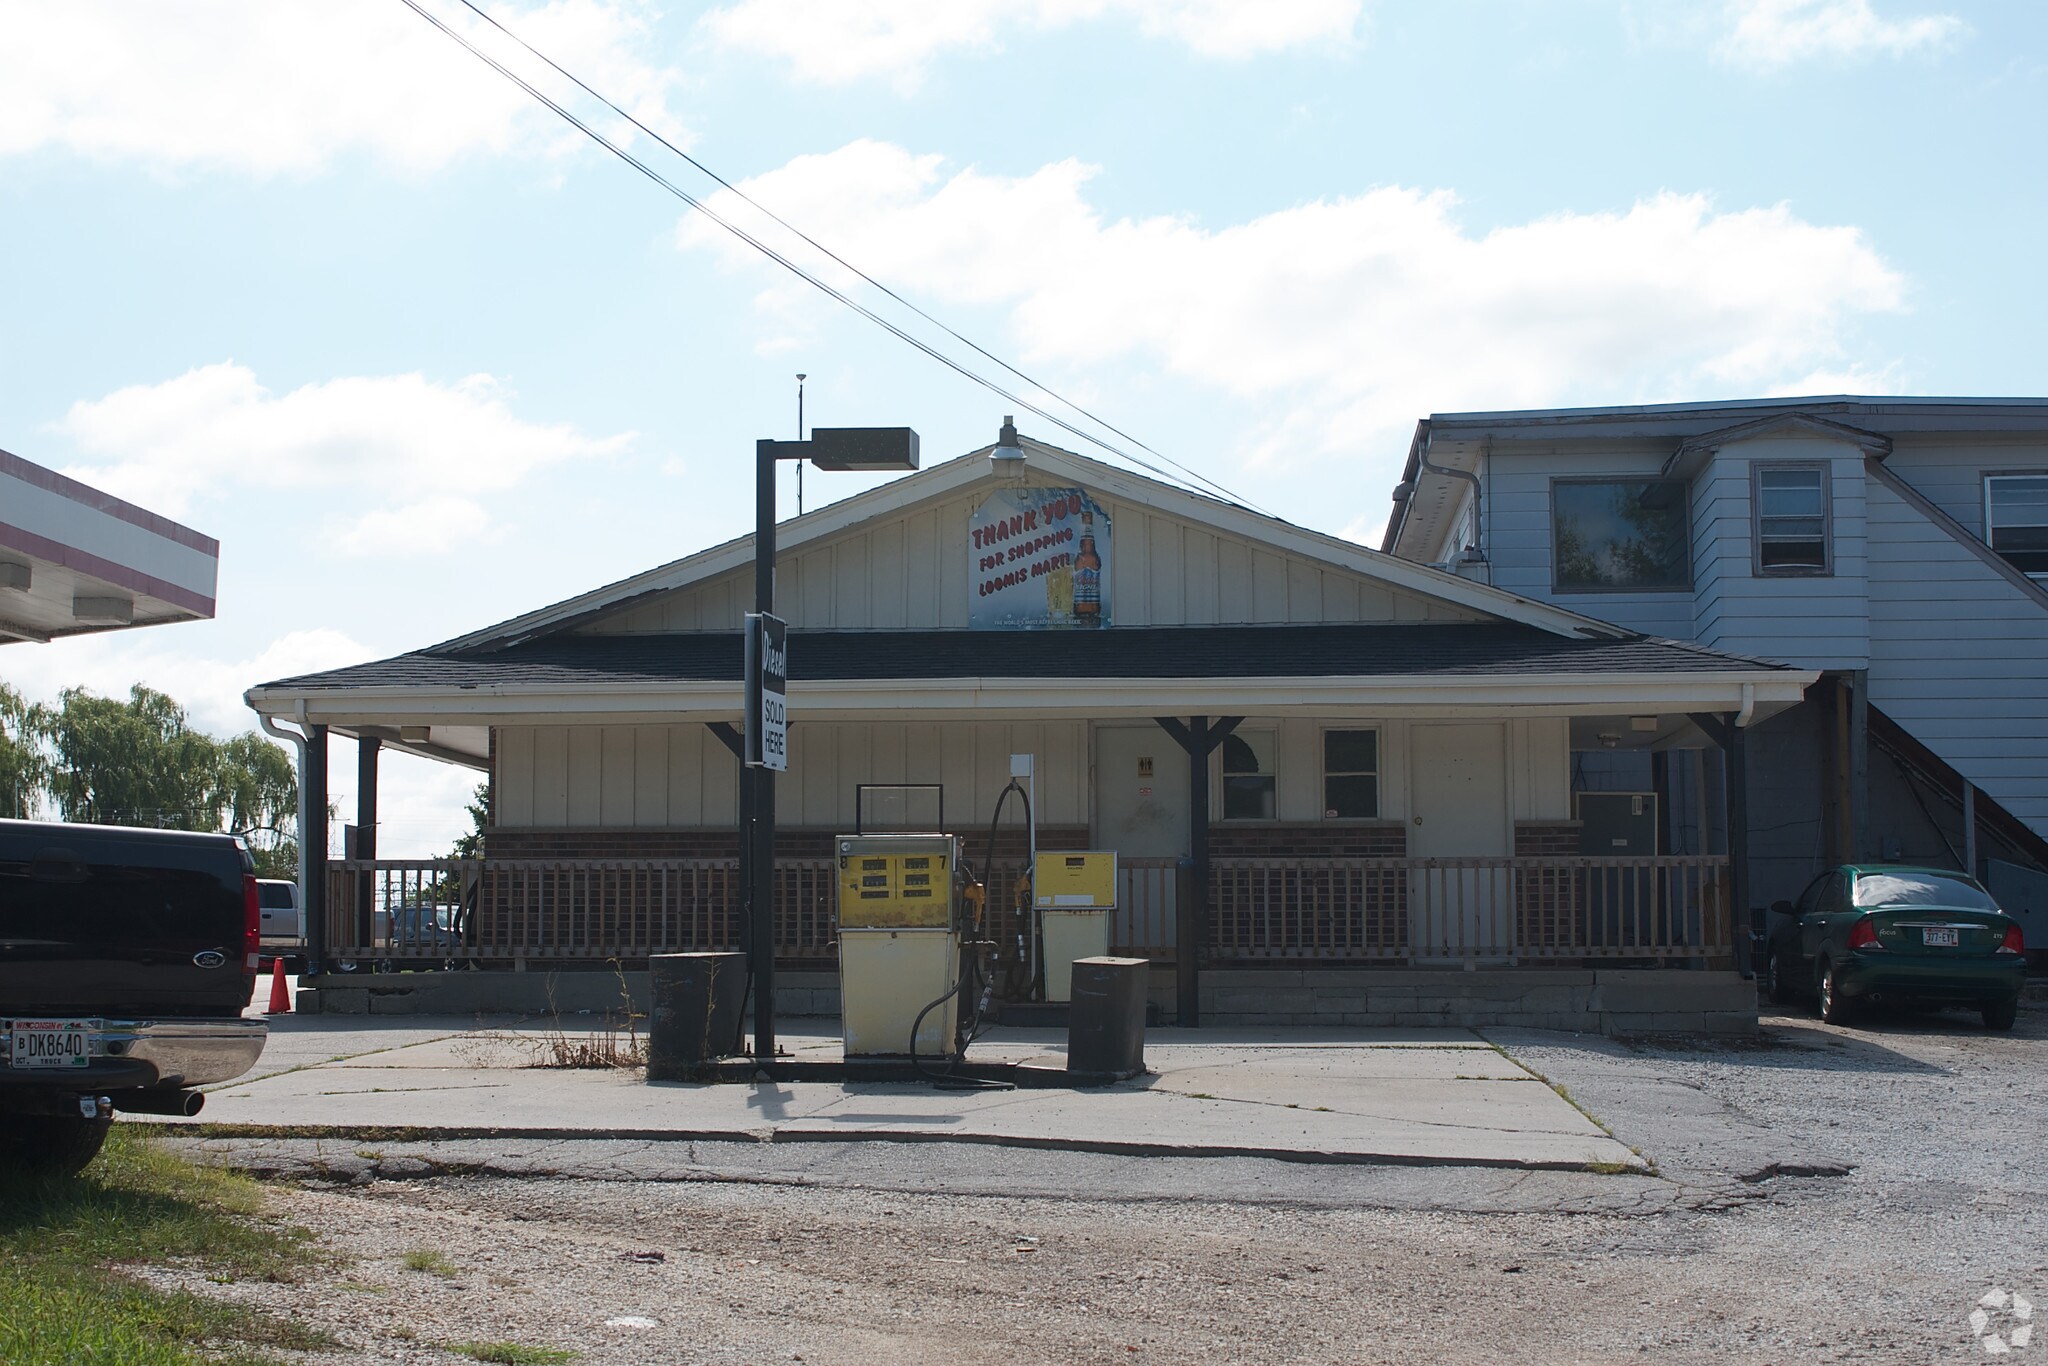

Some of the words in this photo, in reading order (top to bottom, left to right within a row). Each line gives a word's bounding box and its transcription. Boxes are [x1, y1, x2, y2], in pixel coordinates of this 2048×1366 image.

[972, 509, 1037, 549] THANK
[1041, 495, 1082, 525] YOU
[979, 552, 1005, 572] FOR
[1008, 527, 1073, 562] SHOPPING
[979, 568, 1028, 597] LOOMIS
[1031, 552, 1070, 578] MART!
[763, 631, 785, 677] Diesel
[765, 699, 784, 726] SOLD
[765, 729, 784, 755] HERE
[840, 856, 848, 869] 8
[939, 855, 946, 869] 7
[201, 955, 219, 965] Ford
[16, 1021, 57, 1030] WISCONSIN
[30, 1034, 81, 1056] DK8640
[15, 1057, 26, 1065] OCT
